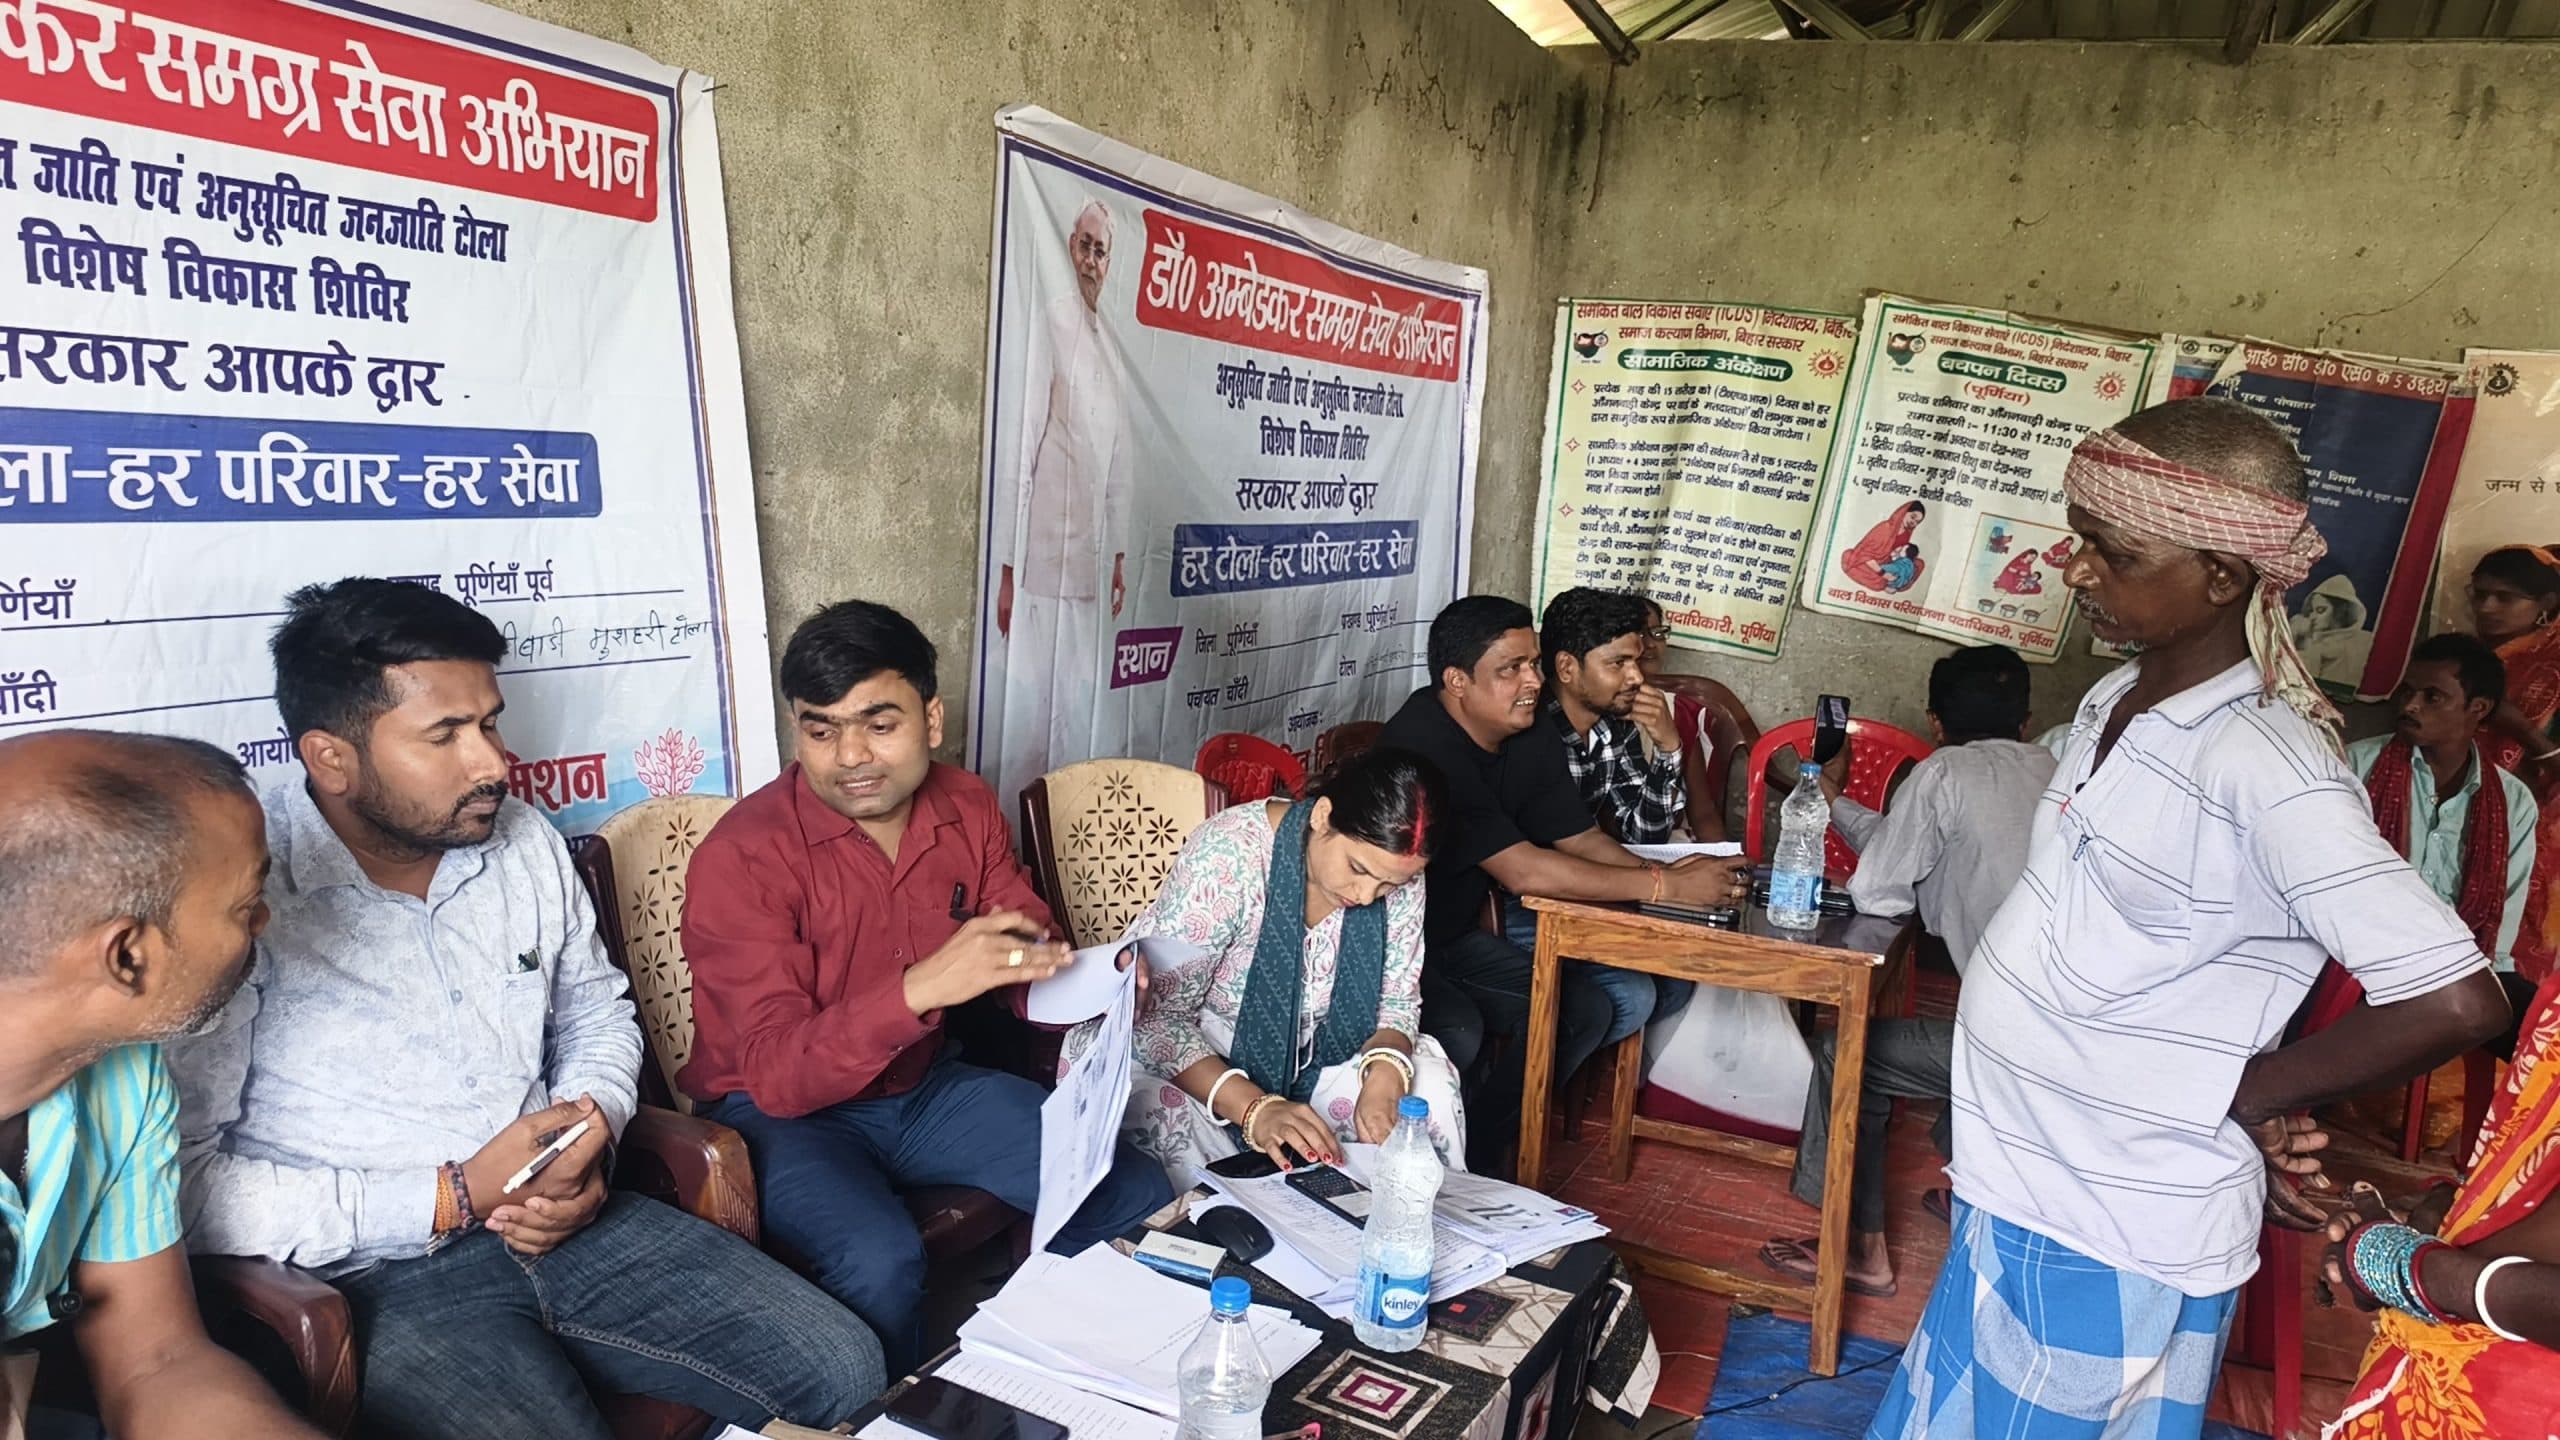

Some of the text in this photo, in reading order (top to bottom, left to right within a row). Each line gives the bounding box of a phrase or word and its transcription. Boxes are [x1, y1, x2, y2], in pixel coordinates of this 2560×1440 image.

[0, 0, 649, 198] कर समग्र सेवा अभियान
[30, 137, 120, 206] जाति
[131, 153, 184, 214] एवं
[196, 172, 329, 247] अनुसूचित
[338, 197, 445, 253] जनजाति
[453, 204, 508, 262] टोला
[18, 217, 411, 323] विशेष विकास शिविर
[1199, 251, 1310, 338] अम्बेडकर
[1306, 289, 1367, 355] समग्र
[1360, 291, 1400, 356] सेवा
[1393, 302, 1457, 367] अभियान
[1619, 327, 1652, 340] समाज
[1655, 328, 1693, 340] कल्याण
[1735, 327, 1765, 347] बिहार
[1766, 335, 1805, 351] सरकार
[1624, 352, 1710, 369] सामाजिक
[1930, 335, 1958, 347] समाज
[1959, 339, 1993, 352] कल्याण
[2055, 356, 2088, 371] सरकार
[1931, 319, 1950, 331] बाल
[1951, 320, 1983, 335] विकास
[2012, 331, 2049, 351] (ICDS)
[2104, 346, 2133, 362] बिहार
[205, 340, 355, 397] आपके
[367, 356, 445, 414] द्वार
[1216, 360, 1266, 410] अनुसूचित
[1267, 366, 1292, 405] जाति
[1295, 370, 1311, 407] एवं
[1311, 376, 1349, 420] अनुसूचित
[1352, 382, 1386, 416] जनजाति
[1941, 358, 2064, 391] बचपन दिवस
[1964, 381, 2031, 406] (पूर्णिया)
[1648, 383, 1661, 395] की
[1816, 404, 1831, 415] हर
[1897, 391, 1930, 405] प्रत्येक
[1932, 395, 1970, 411] शनिवार
[1970, 405, 1986, 415] का
[2074, 424, 2091, 434] पर
[1260, 415, 1370, 461] विशेष विकास शिविर
[1907, 411, 1934, 422] समय
[1936, 415, 1966, 428] सारणी
[1983, 423, 2018, 439] 11:30
[2020, 430, 2032, 442] से
[2035, 433, 2073, 449] 12:30
[0, 443, 202, 509] ला-हर
[500, 442, 580, 508] सेवा
[1236, 473, 1378, 516] सरकार आपके द्वार
[2485, 480, 2521, 492] जन्म
[2529, 476, 2545, 493] से
[1181, 547, 1213, 588] हर
[1387, 529, 1414, 569] सेवा
[455, 561, 519, 606] पूर्णियाँ
[525, 559, 553, 602] पूर्व
[1665, 609, 1776, 644] पदाधिकारी, पूर्णिया
[1828, 588, 1853, 600] बाल
[1855, 590, 1890, 609] विकास
[1948, 615, 2013, 640] पदाधिकारी,
[2018, 631, 2055, 648] पूर्णिया
[1117, 641, 1172, 679] स्थान
[1196, 628, 1217, 655] जिला
[1187, 675, 1249, 709] पंचायत चाँदी
[1384, 1297, 1420, 1311] kinley
